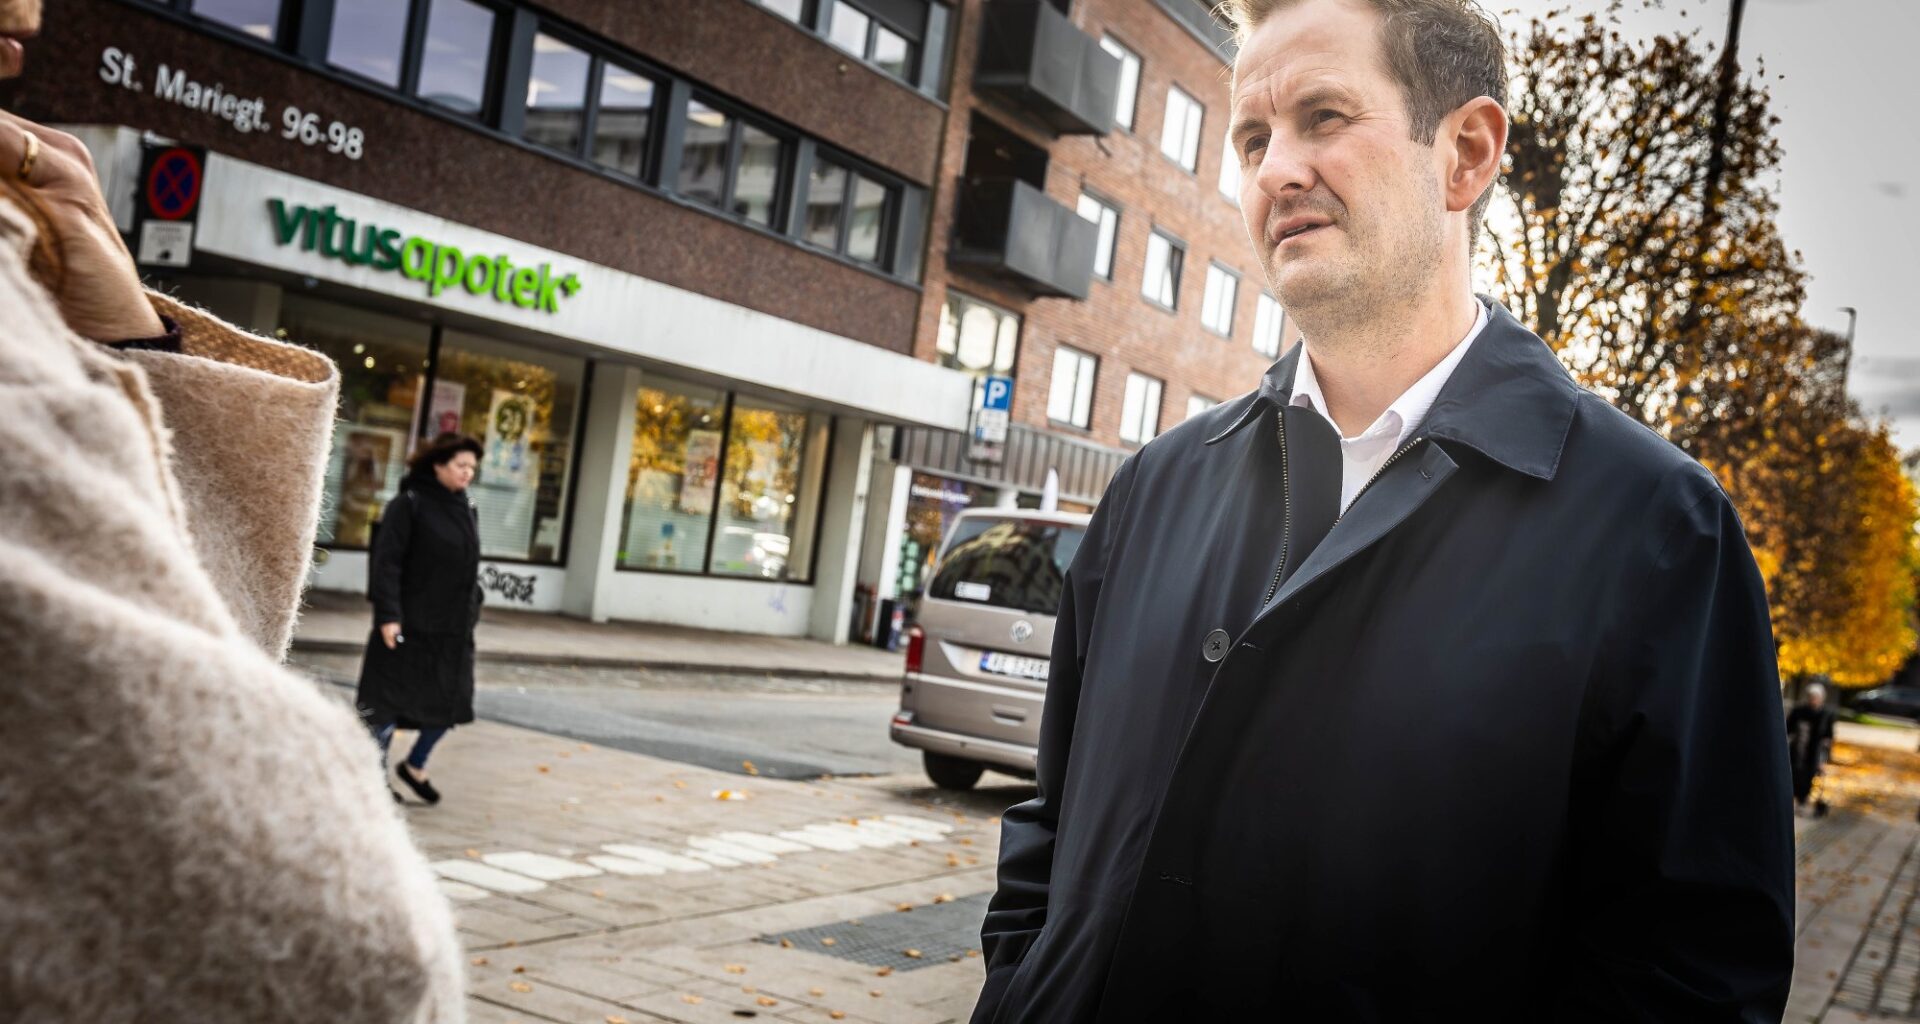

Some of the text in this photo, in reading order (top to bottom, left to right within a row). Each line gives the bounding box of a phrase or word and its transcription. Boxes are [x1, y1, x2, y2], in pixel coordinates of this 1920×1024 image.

[99, 46, 365, 161] St. Mariegt. 96-98
[986, 380, 1007, 407] P
